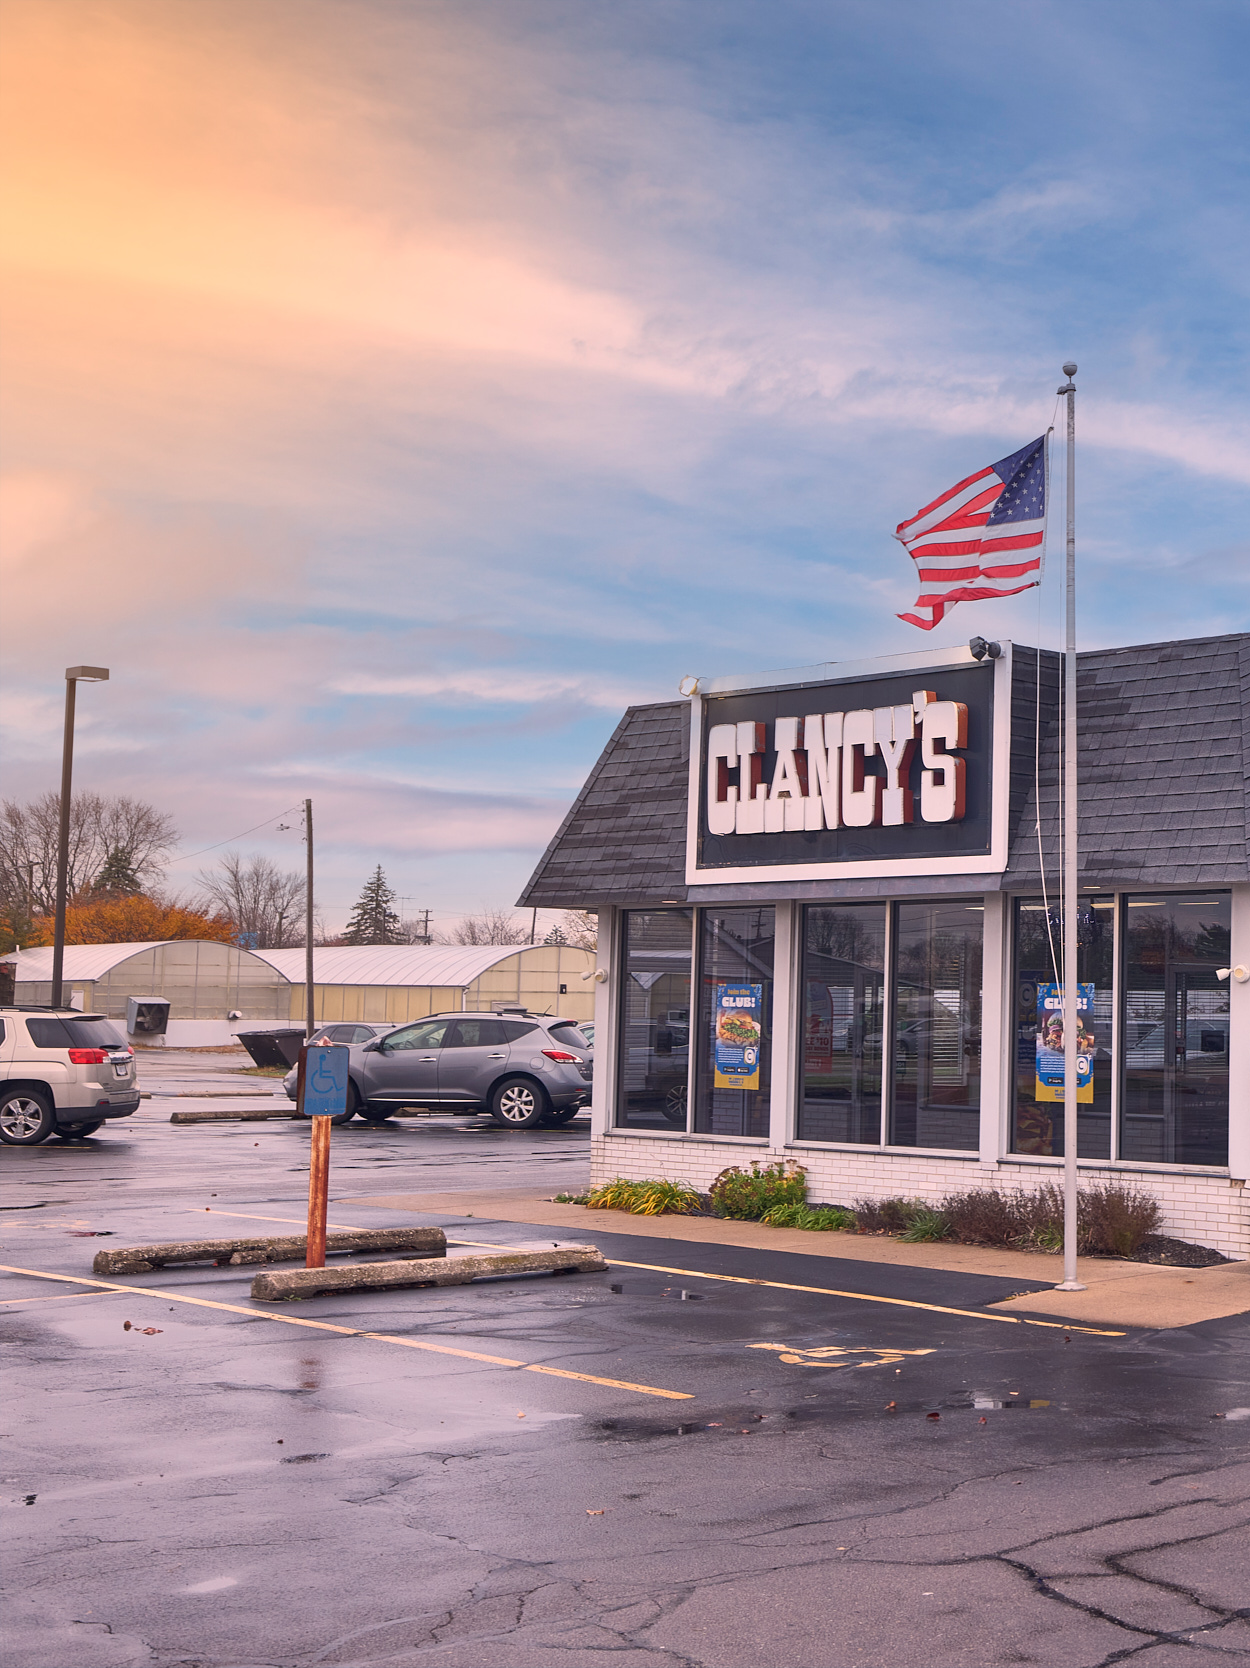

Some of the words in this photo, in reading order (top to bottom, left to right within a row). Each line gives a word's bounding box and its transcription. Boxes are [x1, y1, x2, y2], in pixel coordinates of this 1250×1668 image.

[707, 689, 967, 836] CLANCY'S
[721, 996, 756, 1008] CLUB!
[1044, 997, 1088, 1010] CLB!
